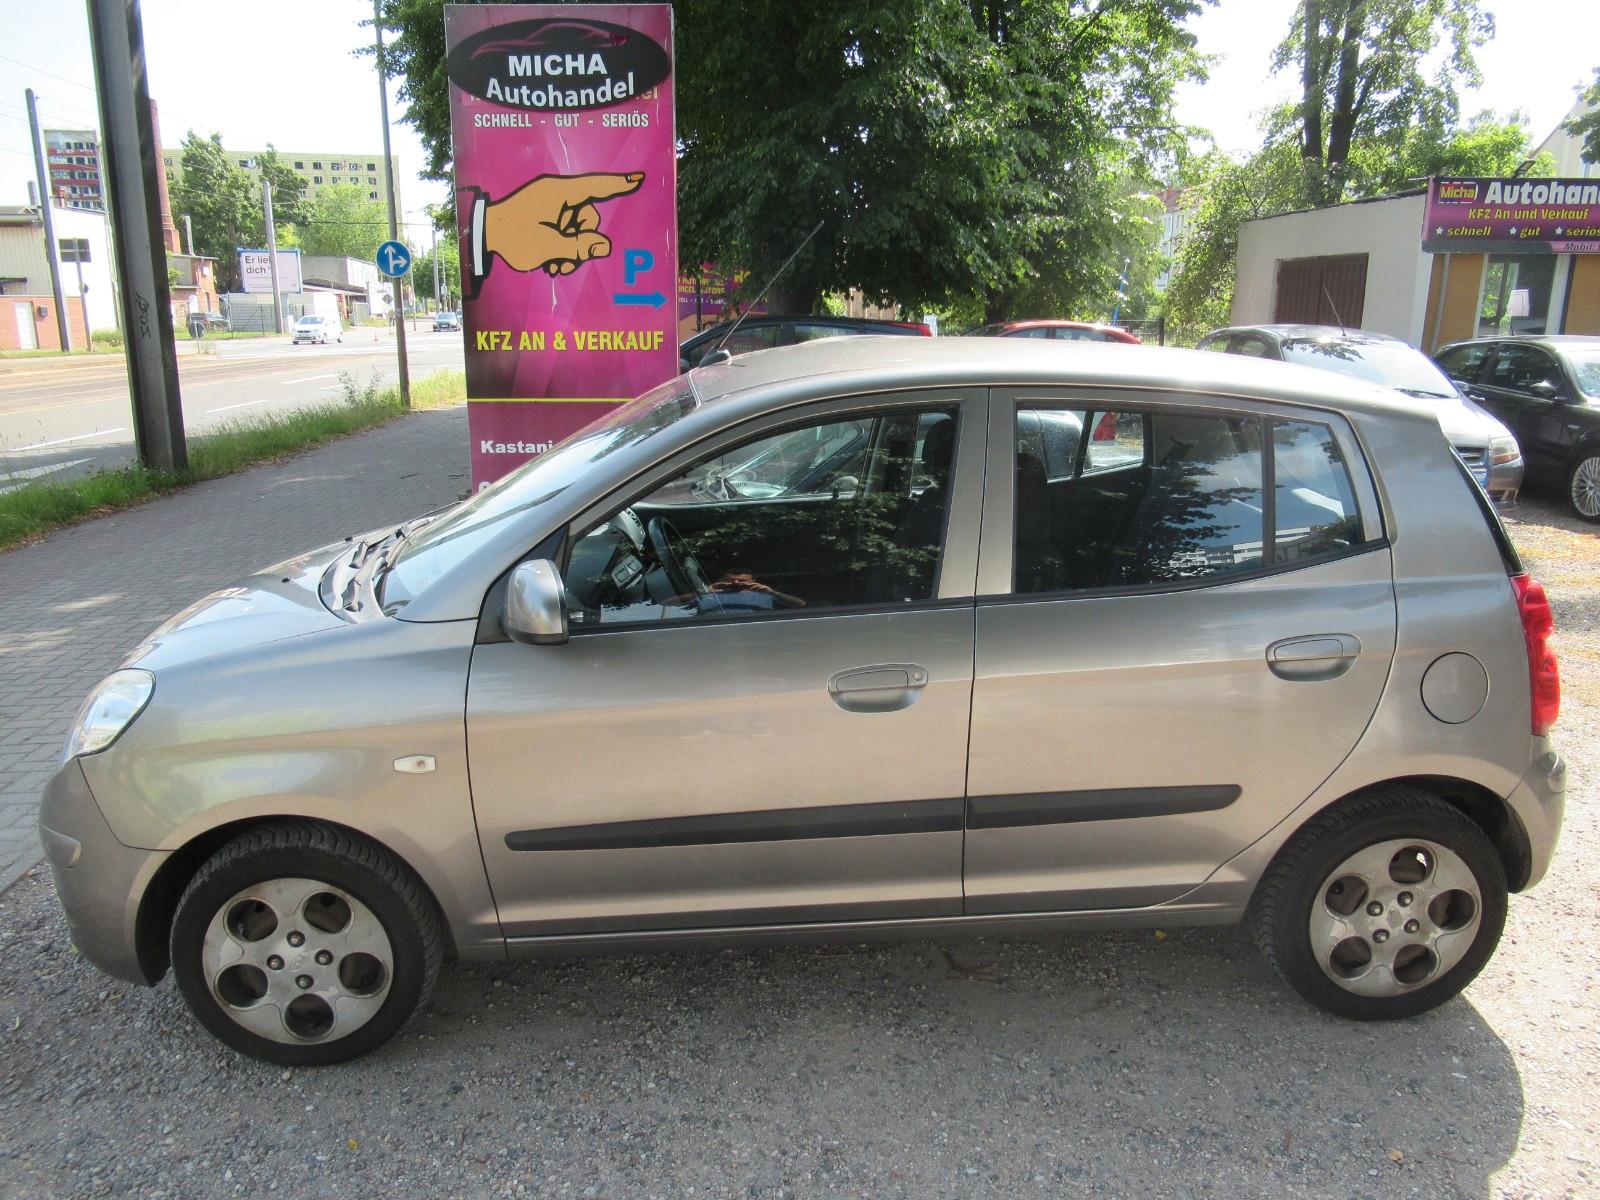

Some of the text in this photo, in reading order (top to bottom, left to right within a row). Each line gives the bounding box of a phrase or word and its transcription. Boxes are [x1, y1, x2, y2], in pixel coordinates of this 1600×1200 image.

[508, 53, 608, 77] MICHA
[486, 72, 635, 108] Autohandel
[474, 113, 533, 128] SCHNELL
[554, 113, 580, 128] GUT
[602, 110, 649, 128] SERIÖS
[1440, 182, 1600, 205] Micha Autohan
[1468, 208, 1589, 219] KFZ An und Verkauf
[1447, 226, 1492, 236] schnell
[1519, 226, 1540, 238] gut
[244, 256, 255, 264] Er
[246, 265, 267, 274] dich
[624, 248, 655, 286] P
[476, 331, 664, 351] KFZ AN & VERKAUF
